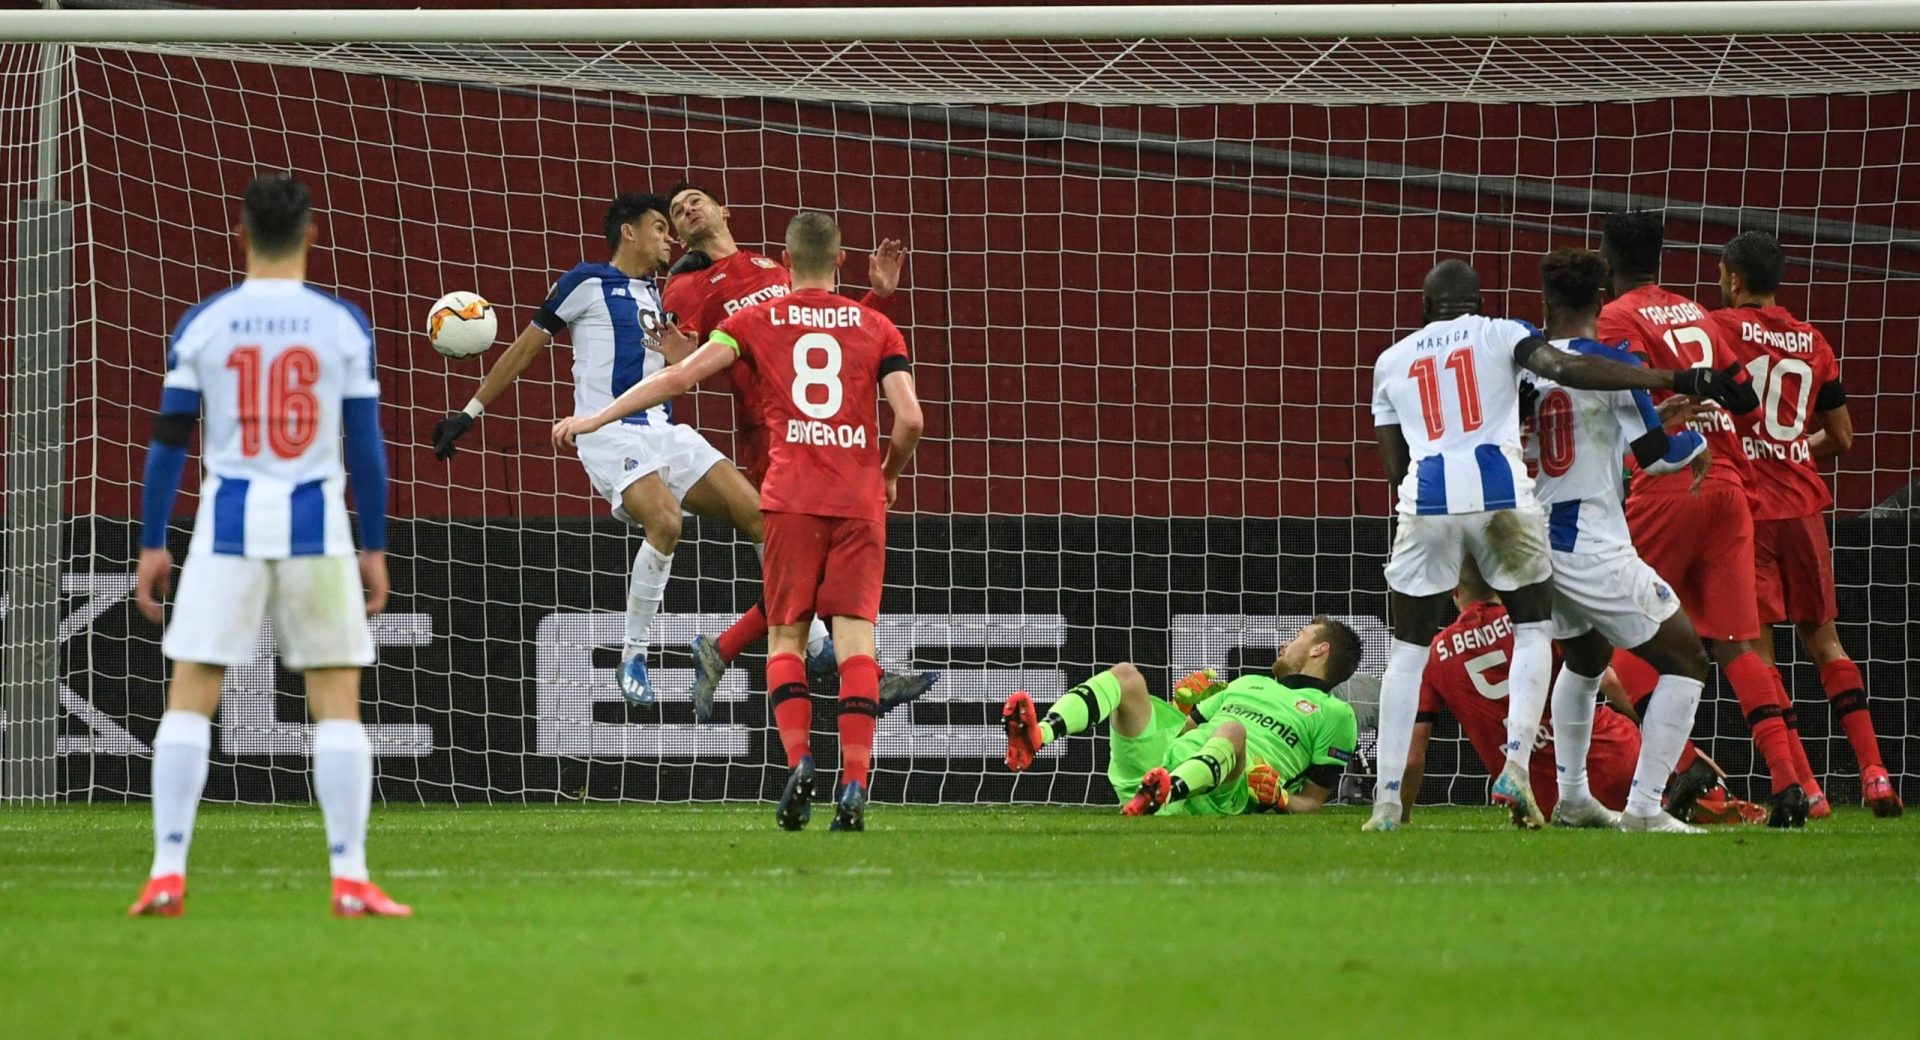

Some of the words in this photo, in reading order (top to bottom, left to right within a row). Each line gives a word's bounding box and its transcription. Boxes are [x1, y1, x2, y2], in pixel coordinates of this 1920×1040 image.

[723, 283, 791, 316] Barmeni
[1638, 302, 1704, 326] TAPSOBA
[230, 318, 313, 334] MATHEUS
[770, 307, 785, 326] L.
[788, 305, 861, 329] BENDER
[1416, 329, 1470, 351] MAREGA
[1741, 321, 1814, 354] DEMIRBAY
[791, 332, 843, 420] 8
[225, 344, 321, 461] 16
[1407, 345, 1484, 442] 11
[1745, 354, 1813, 442] 10
[837, 424, 867, 450] 04
[1436, 639, 1453, 662] S.
[1463, 649, 1510, 700] 5
[1221, 703, 1300, 749] Barmenia
